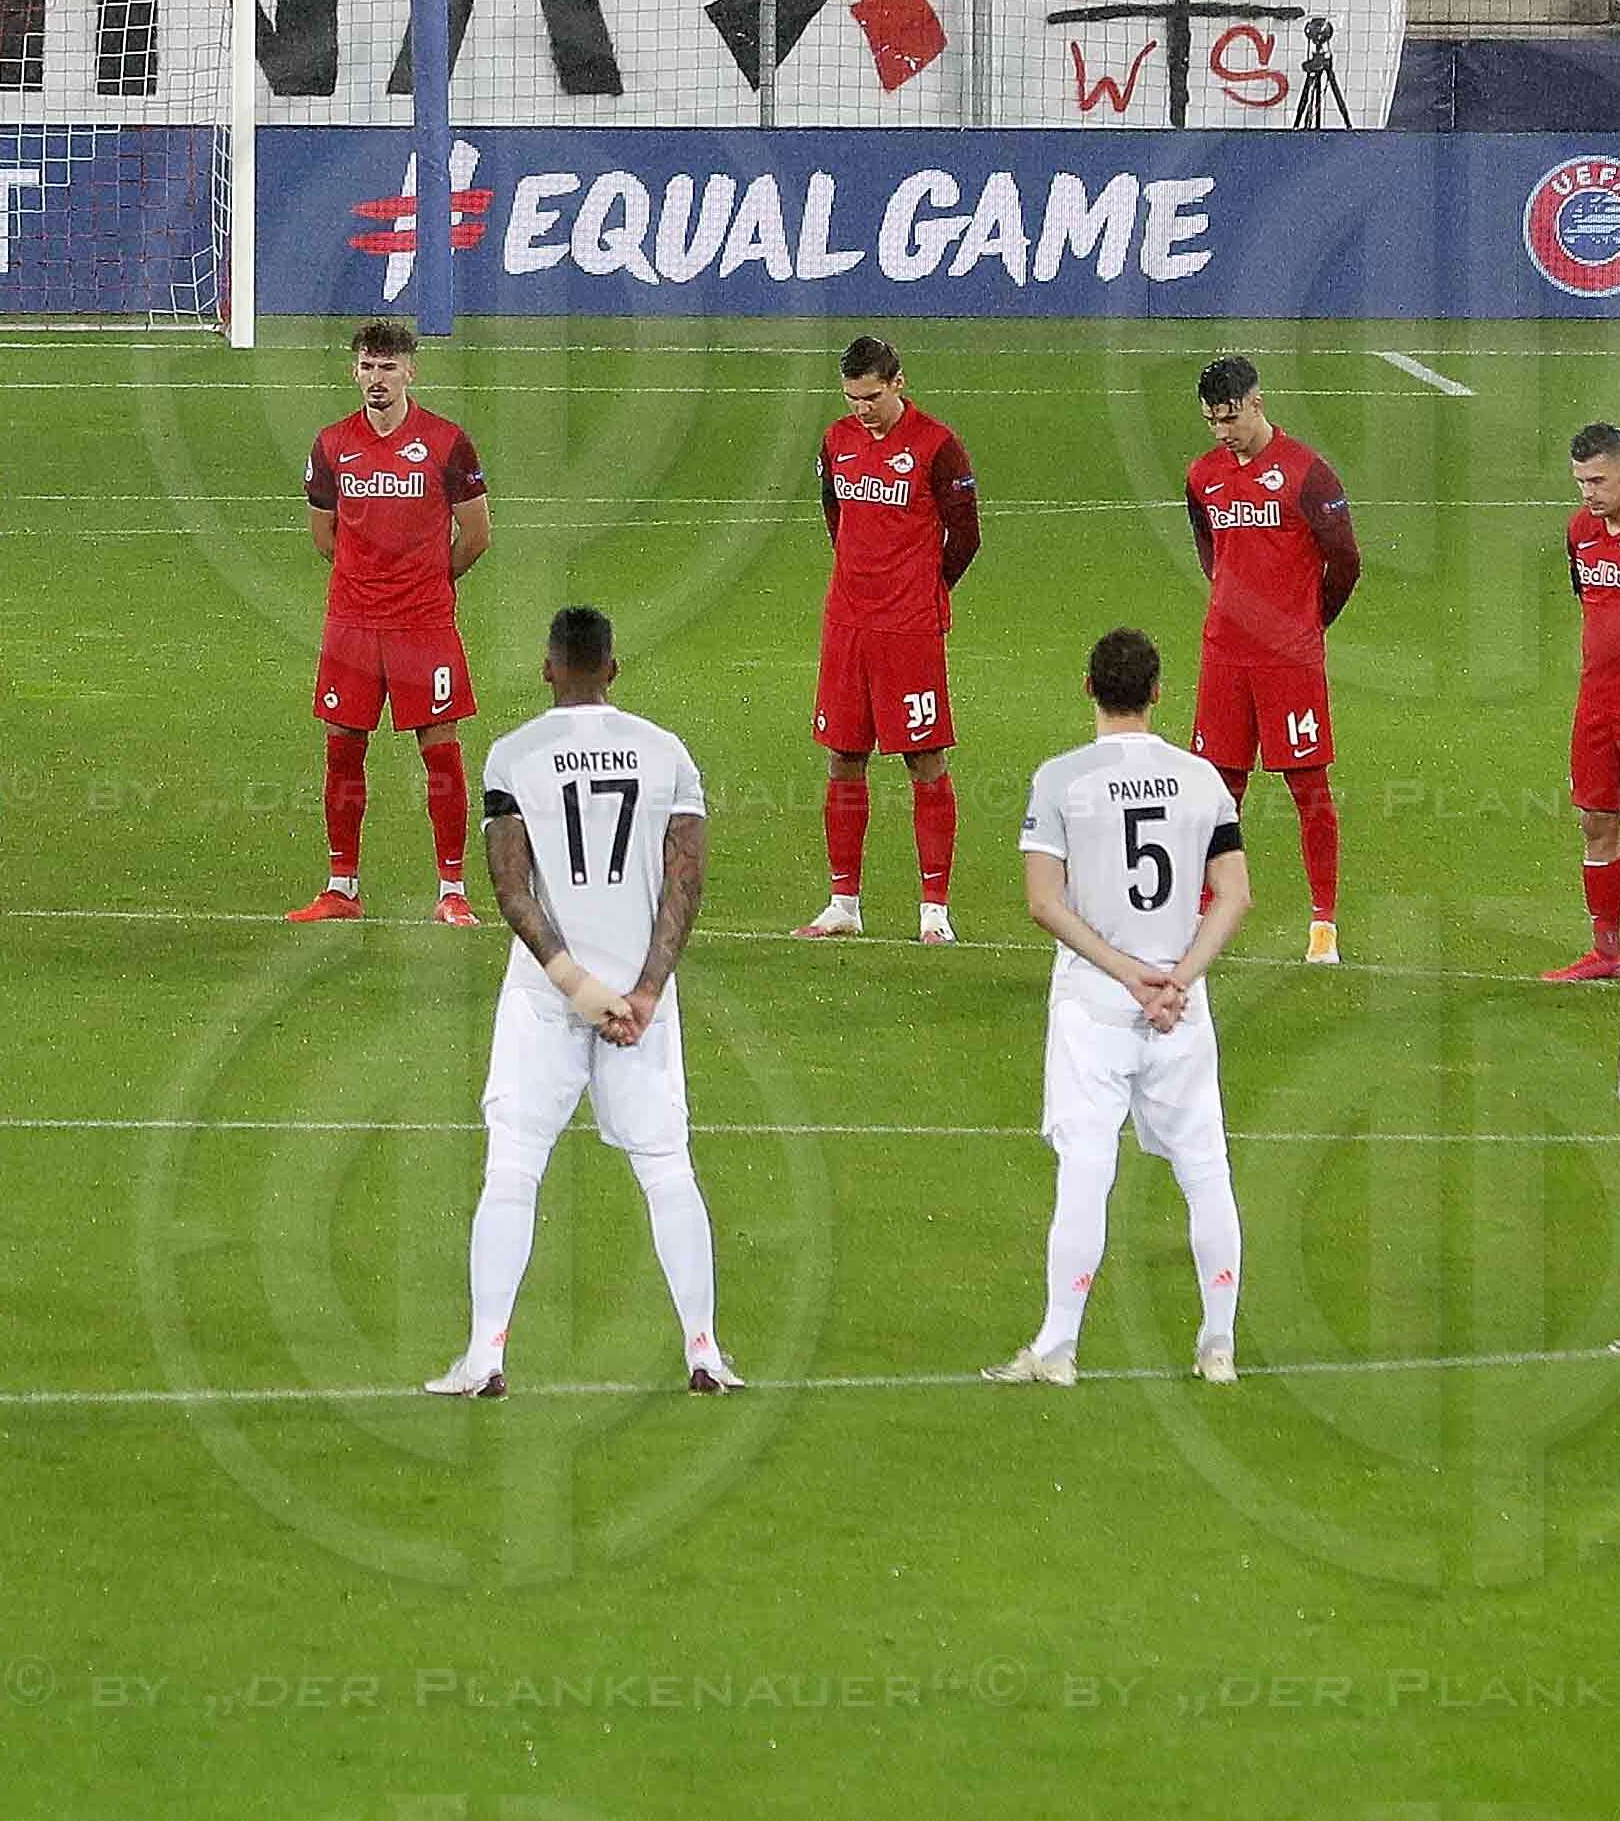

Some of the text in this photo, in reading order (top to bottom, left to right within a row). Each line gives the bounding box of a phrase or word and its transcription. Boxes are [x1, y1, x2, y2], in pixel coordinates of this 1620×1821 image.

[433, 665, 452, 703] 8
[903, 690, 937, 729] 39
[1286, 708, 1320, 747] 14
[553, 749, 640, 775] BOATENG
[1108, 775, 1180, 803] PAVARD
[561, 777, 641, 886] 17
[1122, 806, 1174, 913] 5
